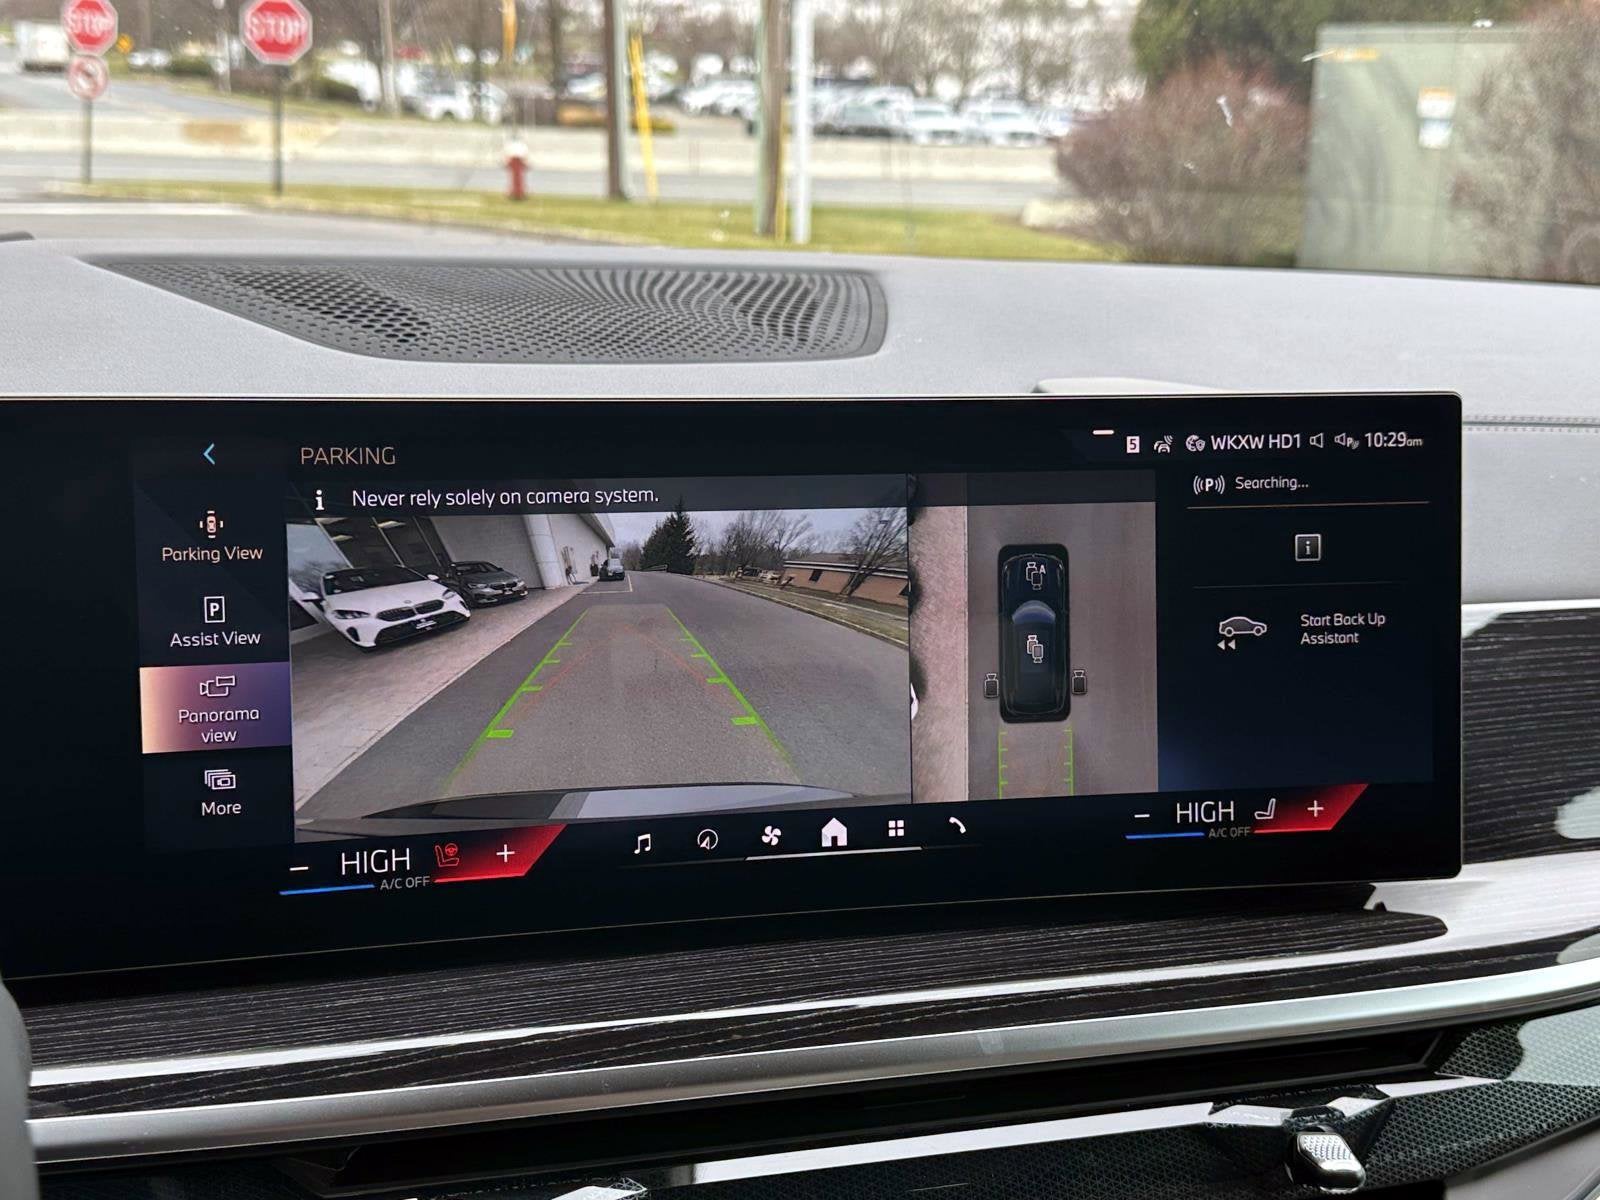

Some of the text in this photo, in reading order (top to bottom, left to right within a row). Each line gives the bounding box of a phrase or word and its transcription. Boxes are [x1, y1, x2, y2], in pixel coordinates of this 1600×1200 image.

[246, 17, 307, 43] STOP
[1211, 434, 1301, 450] WKXW HD1
[300, 446, 396, 466] PARKING
[352, 487, 660, 508] Never rely solely on camera system.
[162, 546, 263, 564] Parking View
[1300, 612, 1385, 627] Start Back Up
[170, 631, 261, 647] Assist View
[1300, 632, 1360, 646] Assistant
[178, 708, 260, 724] Panorama
[201, 728, 238, 743] view
[201, 800, 242, 816] More
[1176, 800, 1235, 824] HIGH
[1208, 826, 1251, 839] A/C OFF
[341, 848, 411, 875] HIGH
[380, 875, 431, 890] A/C OFF
